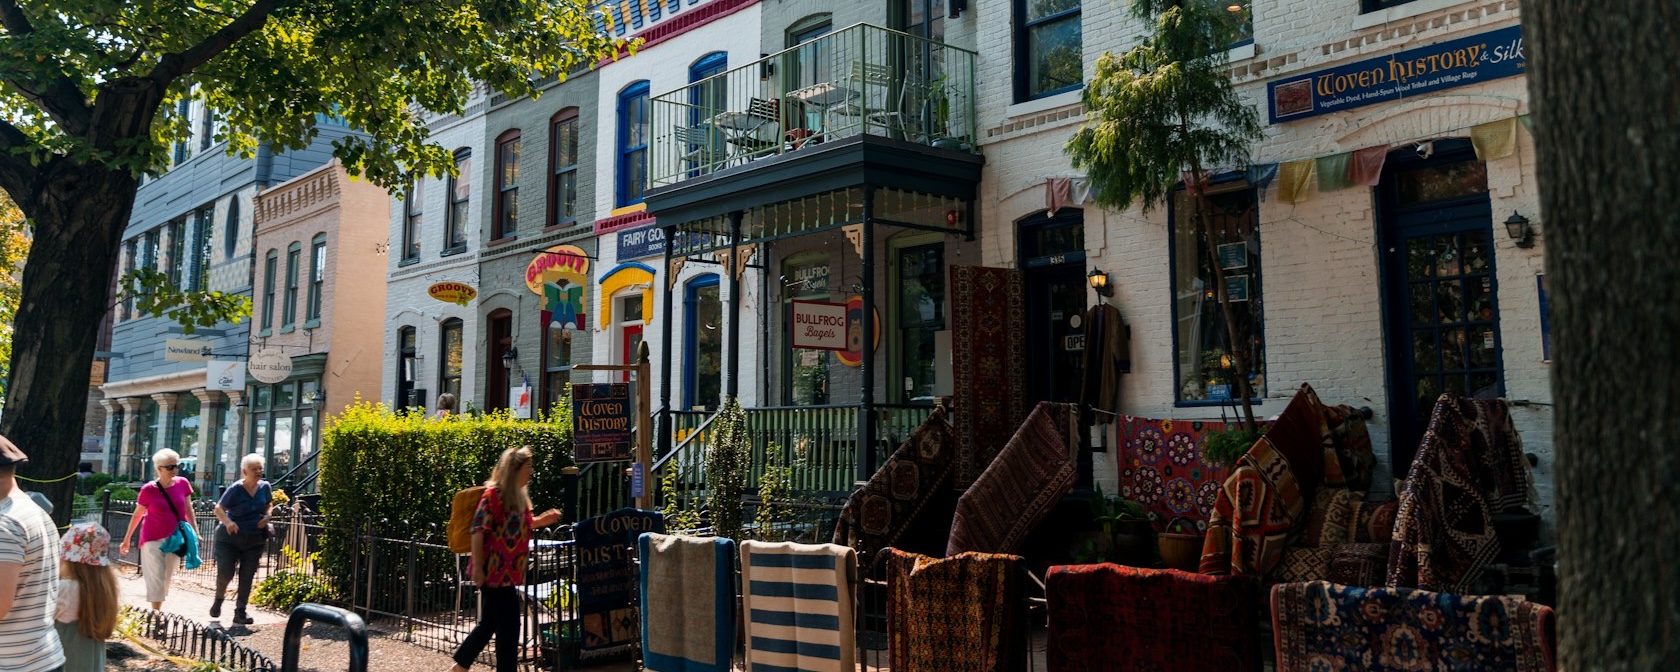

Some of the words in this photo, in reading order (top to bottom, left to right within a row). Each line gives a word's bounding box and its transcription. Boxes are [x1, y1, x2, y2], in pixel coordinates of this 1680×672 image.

[1317, 67, 1384, 97] WOVEN
[1386, 44, 1480, 83] HISTORY
[1490, 38, 1526, 64] Silk
[1320, 97, 1345, 109] Vegetable
[1361, 88, 1395, 100] Hand-Spun
[1395, 83, 1411, 93] Wool
[1411, 80, 1427, 89] Tribal
[1428, 77, 1440, 86] and
[1440, 74, 1461, 84] Village
[1462, 70, 1478, 80] Rugs
[623, 230, 647, 247] FAIRY
[648, 243, 662, 252] BOOKS
[527, 249, 585, 282] GROOVY
[430, 283, 475, 297] GROOVY
[796, 313, 844, 327] BULLFROG
[804, 325, 835, 340] Bagels
[1067, 336, 1085, 349] OPE
[168, 346, 200, 355] Newland
[250, 361, 267, 370] hair
[270, 363, 291, 371] salon
[581, 400, 623, 416] WOVEN
[578, 416, 628, 433] HISTORY
[595, 516, 653, 535] WOVEN
